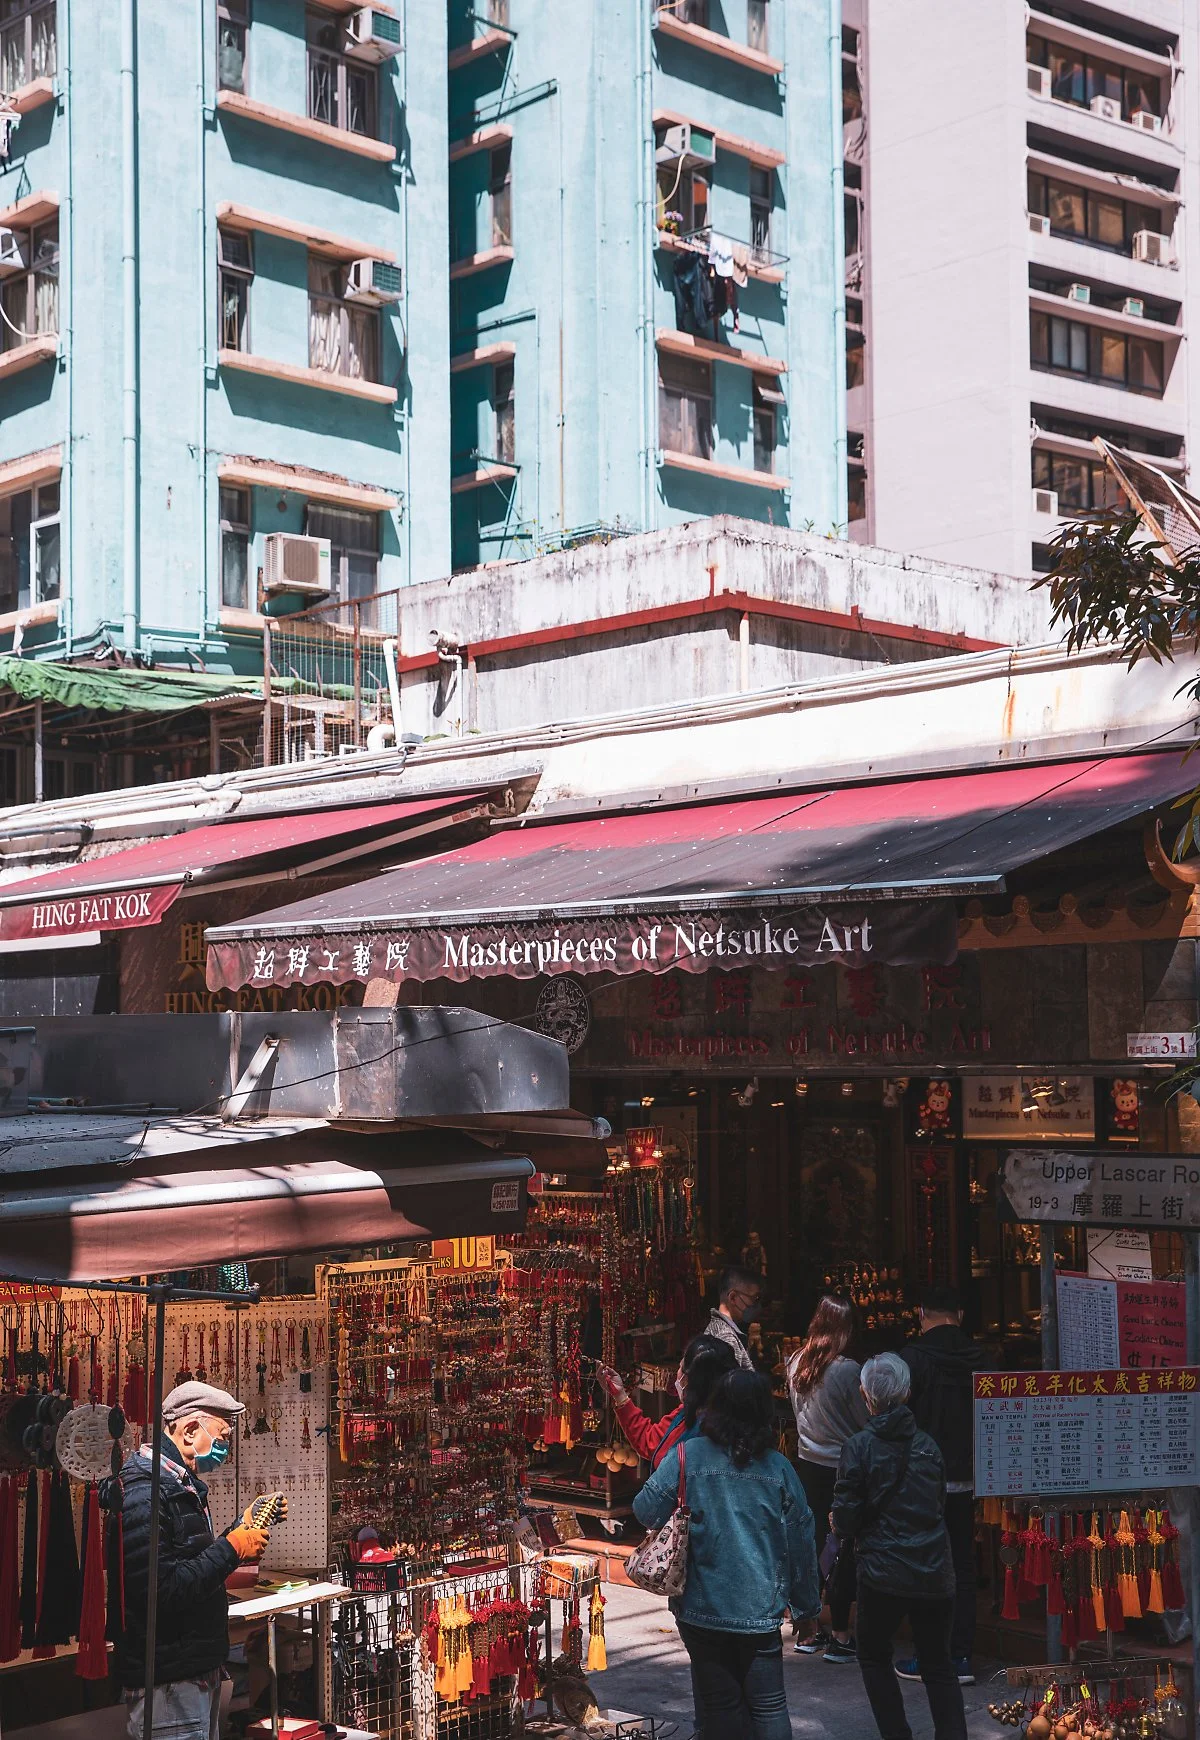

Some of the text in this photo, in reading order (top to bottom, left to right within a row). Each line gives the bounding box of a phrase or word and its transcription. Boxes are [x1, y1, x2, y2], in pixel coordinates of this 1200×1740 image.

[32, 893, 151, 928] HING FAT KOK
[442, 917, 873, 971] Masterpieces of Netsuke Art
[164, 984, 353, 1013] HING FAT KOK
[631, 1023, 991, 1061] Masterpieces of Netsuke Art
[969, 1108, 1019, 1120] Masterpieces
[1038, 1109, 1070, 1119] Netsuke
[1075, 1108, 1091, 1119] Art
[1042, 1161, 1200, 1184] Upper Lascar Ro
[1029, 1196, 1059, 1210] 19-3
[1072, 1192, 1185, 1220] 摩羅上街
[977, 1370, 1197, 1397] 癸卯兔年化太歲吉祥物
[985, 1400, 1024, 1412] 文武廟
